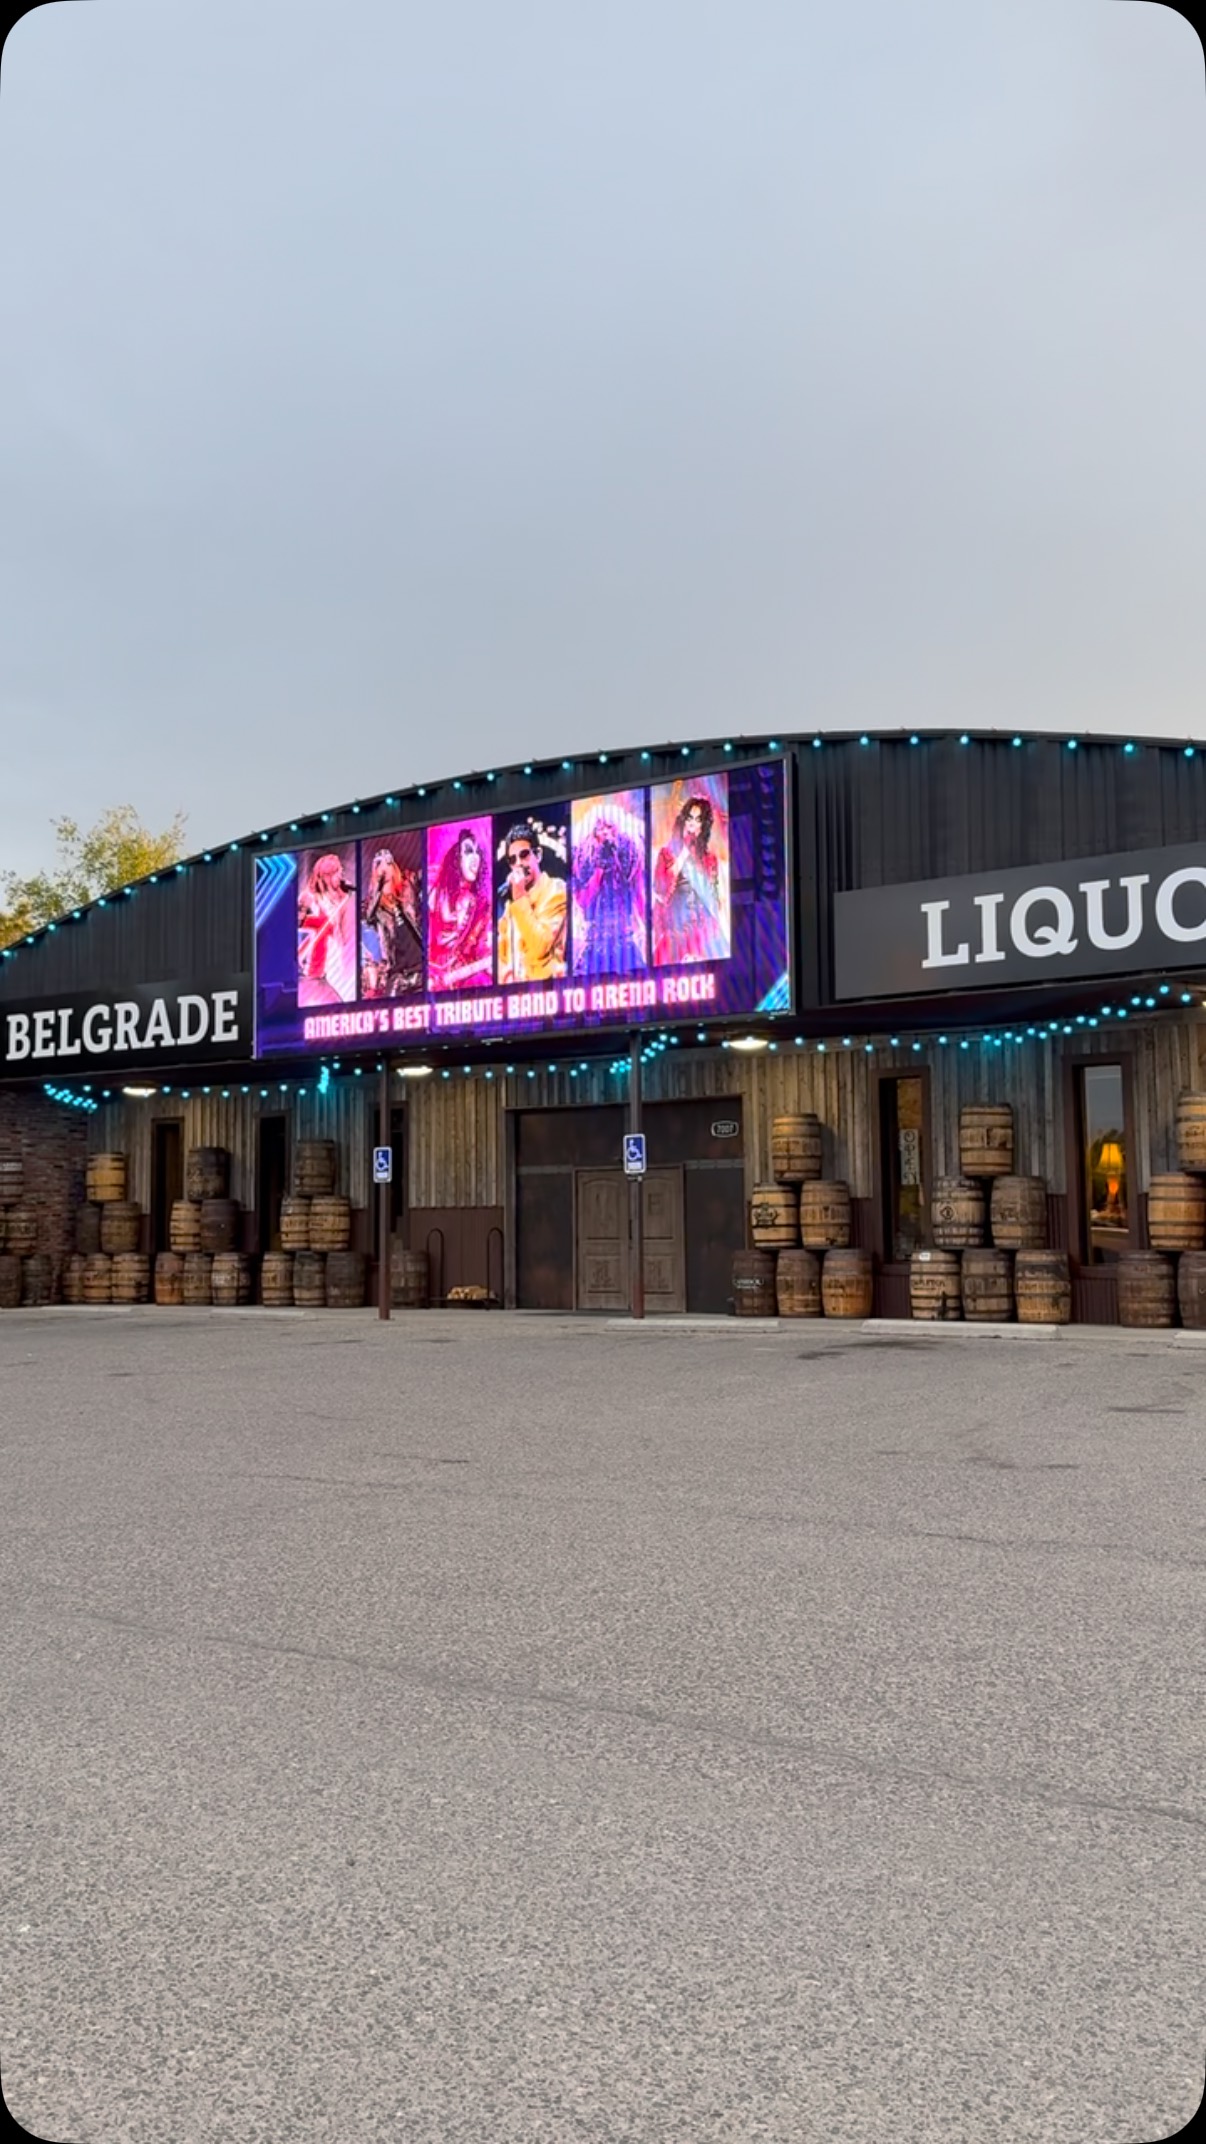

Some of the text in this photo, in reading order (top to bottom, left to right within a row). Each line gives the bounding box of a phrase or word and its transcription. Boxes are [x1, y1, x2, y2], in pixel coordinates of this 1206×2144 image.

[920, 867, 1206, 969] LIQUO
[6, 991, 238, 1060] BELGRADE
[304, 973, 715, 1039] AMERICA'S BEST TRIBUTE BAND TO ARENA ROCK
